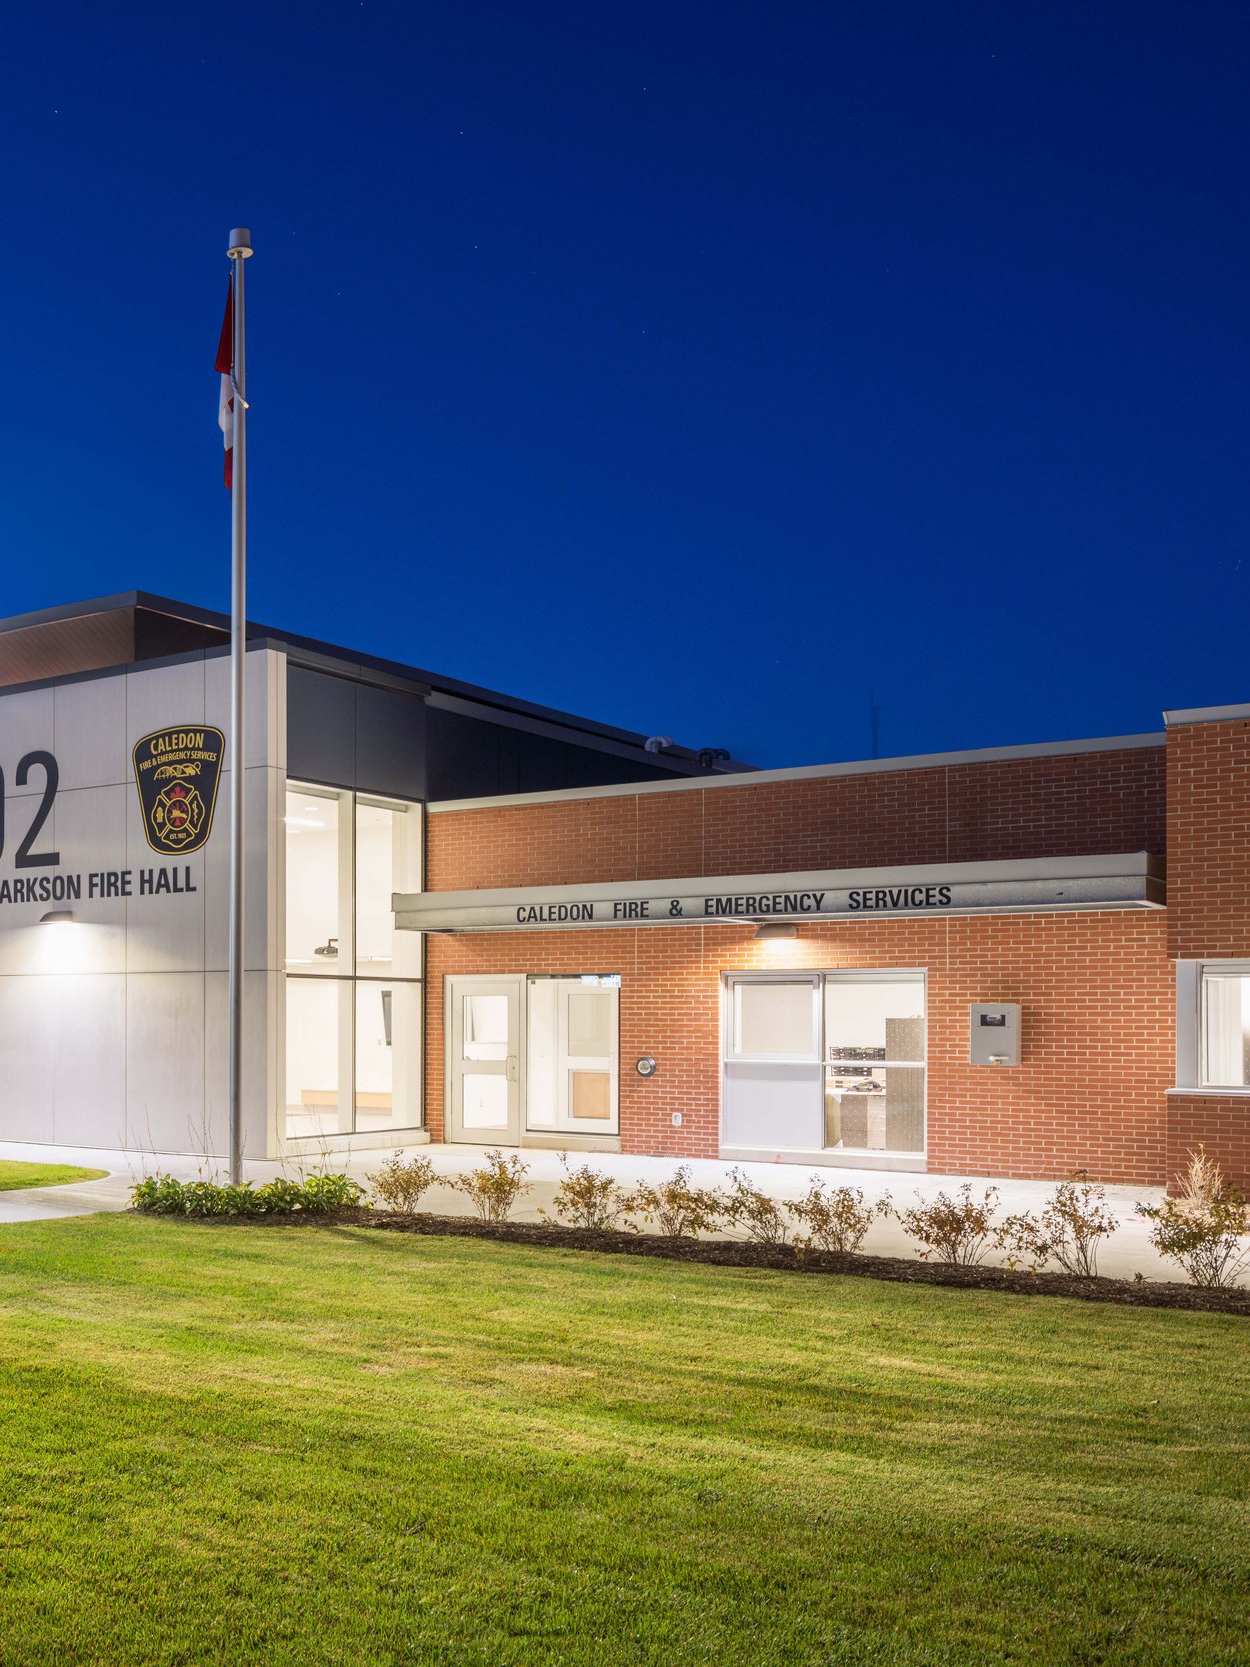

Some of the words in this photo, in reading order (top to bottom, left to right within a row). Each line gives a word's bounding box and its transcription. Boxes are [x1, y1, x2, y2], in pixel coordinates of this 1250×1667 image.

[150, 733, 204, 755] CALEDON
[139, 760, 152, 772] FIRE
[152, 757, 158, 766] &
[157, 750, 190, 765] EMERGENCY
[191, 750, 217, 762] SERVICES
[88, 870, 132, 899] FIRE
[139, 866, 197, 895] HALL
[516, 903, 594, 923] CALEDON
[613, 901, 650, 919] FIRE
[669, 899, 683, 917] &
[704, 893, 825, 915] EMERGENCY
[848, 886, 952, 910] SERVICES
